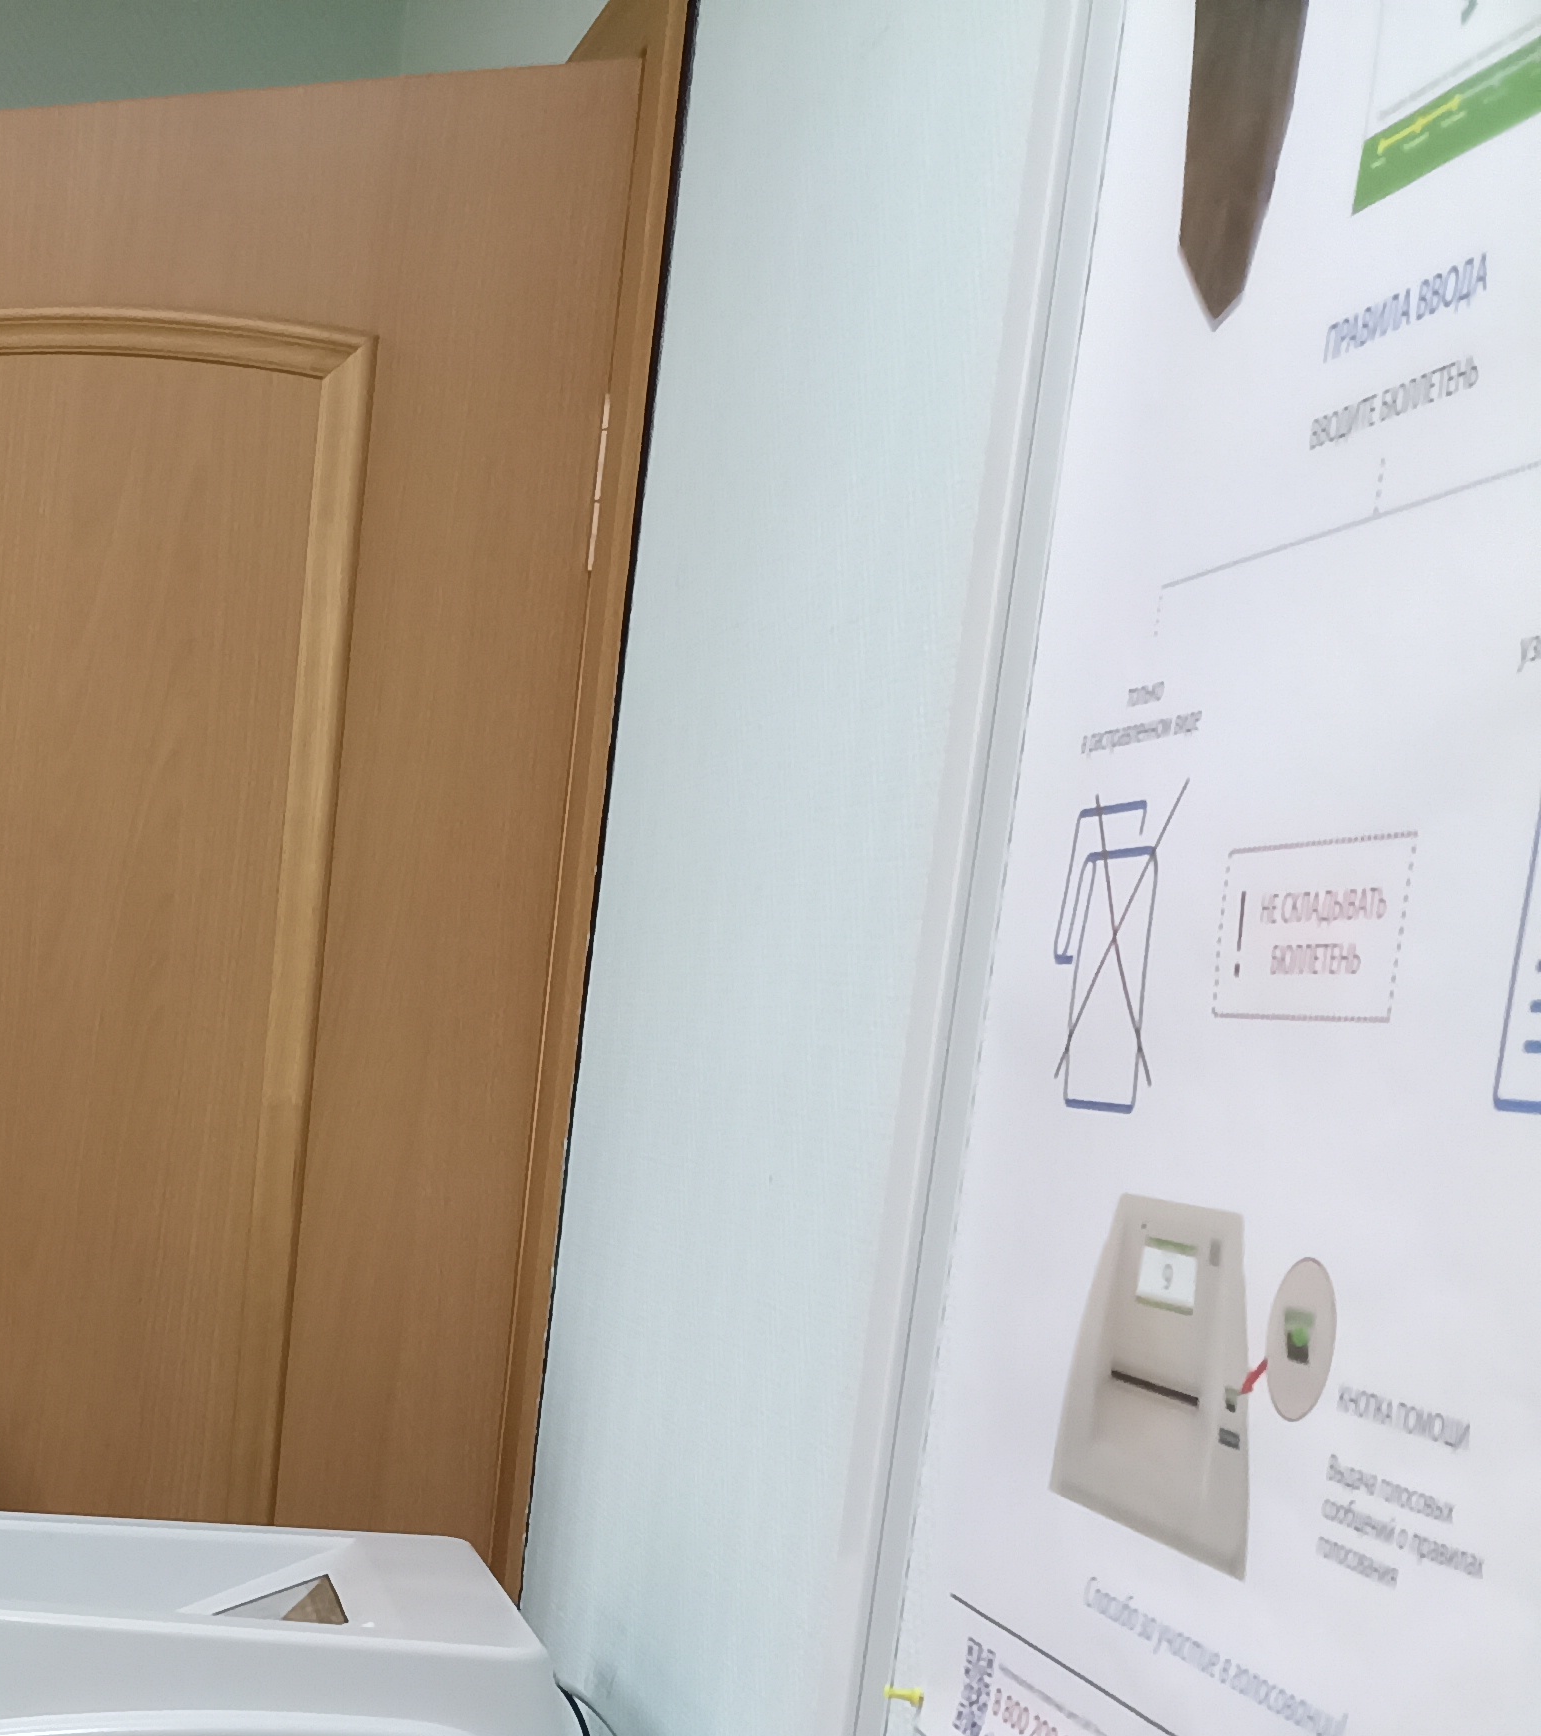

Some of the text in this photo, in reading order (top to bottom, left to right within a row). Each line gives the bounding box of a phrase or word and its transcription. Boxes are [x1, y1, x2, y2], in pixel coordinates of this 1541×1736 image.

[1322, 251, 1488, 364] ПРАВИЛА ВВОДА
[1259, 886, 1388, 926] НЕ СКЛАДЫВАТЬ
[1270, 942, 1362, 975] БЮЛЛЕТЕНЬ
[991, 1687, 1003, 1717] 8
[1001, 1694, 1030, 1735] 800
